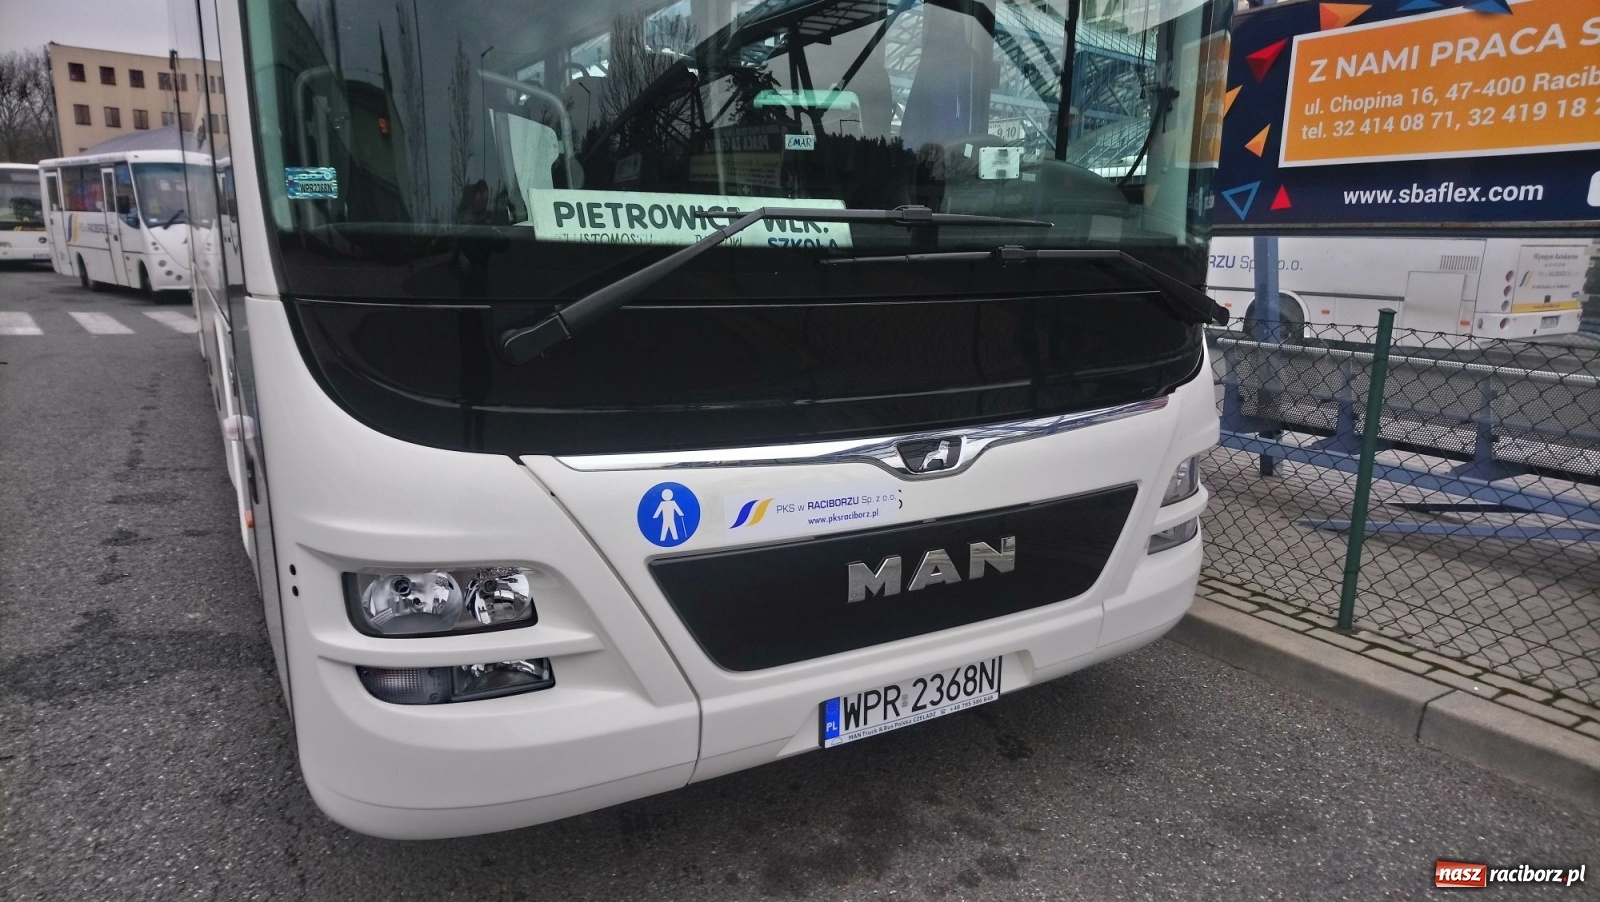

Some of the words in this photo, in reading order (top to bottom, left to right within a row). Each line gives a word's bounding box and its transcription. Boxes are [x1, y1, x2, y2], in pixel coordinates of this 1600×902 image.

[1308, 58, 1328, 83] Z
[1335, 45, 1420, 80] NAMI
[1430, 24, 1567, 67] PRACA
[1304, 98, 1324, 115] ul.
[1330, 91, 1403, 114] Chopina
[1411, 86, 1439, 106] 16,
[1445, 75, 1526, 101] 47-400
[1532, 65, 1600, 93] Racib
[1302, 121, 1327, 139] tel.
[1333, 120, 1355, 137] 32
[1360, 116, 1394, 134] 414
[1400, 113, 1424, 132] 08
[1431, 111, 1460, 131] 71,
[1468, 107, 1495, 126] 32
[1501, 101, 1547, 123] 419
[1557, 97, 1587, 119] 18
[1343, 182, 1544, 204] www.sbaflex.com
[776, 503, 795, 514] PKS
[807, 496, 860, 510] RACIBORZU
[861, 495, 875, 505] Sp.
[882, 494, 897, 502] o.o.
[808, 508, 879, 525] www.pksraciborz.pl
[846, 536, 1016, 603] MAN
[826, 721, 838, 733] PL
[843, 685, 901, 731] WPR
[911, 658, 996, 713] 2368N
[848, 732, 862, 741] MAN
[862, 728, 878, 738] Truck
[894, 719, 912, 728] Polska
